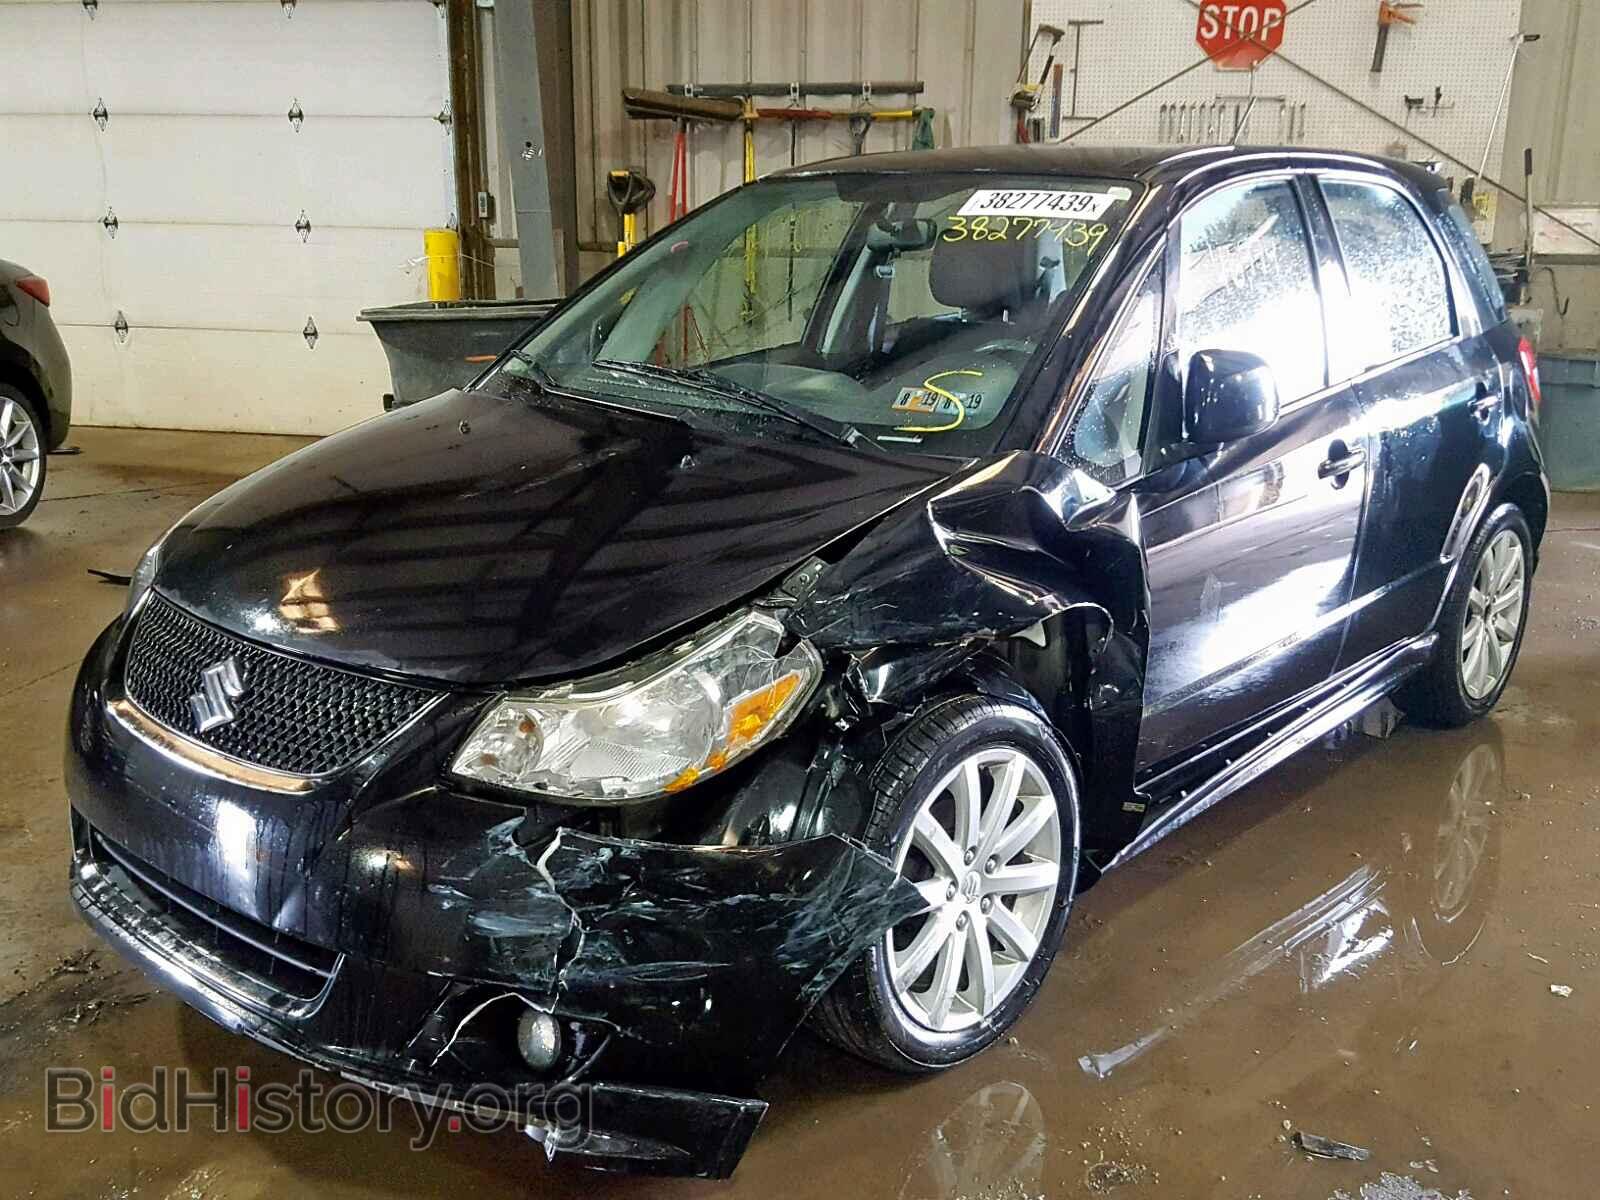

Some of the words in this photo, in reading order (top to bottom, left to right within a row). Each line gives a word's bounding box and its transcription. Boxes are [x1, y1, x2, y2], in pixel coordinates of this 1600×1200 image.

[1200, 4, 1282, 41] STOP
[943, 216, 1109, 256] 38277439
[921, 391, 938, 406] 19
[966, 393, 982, 409] 19
